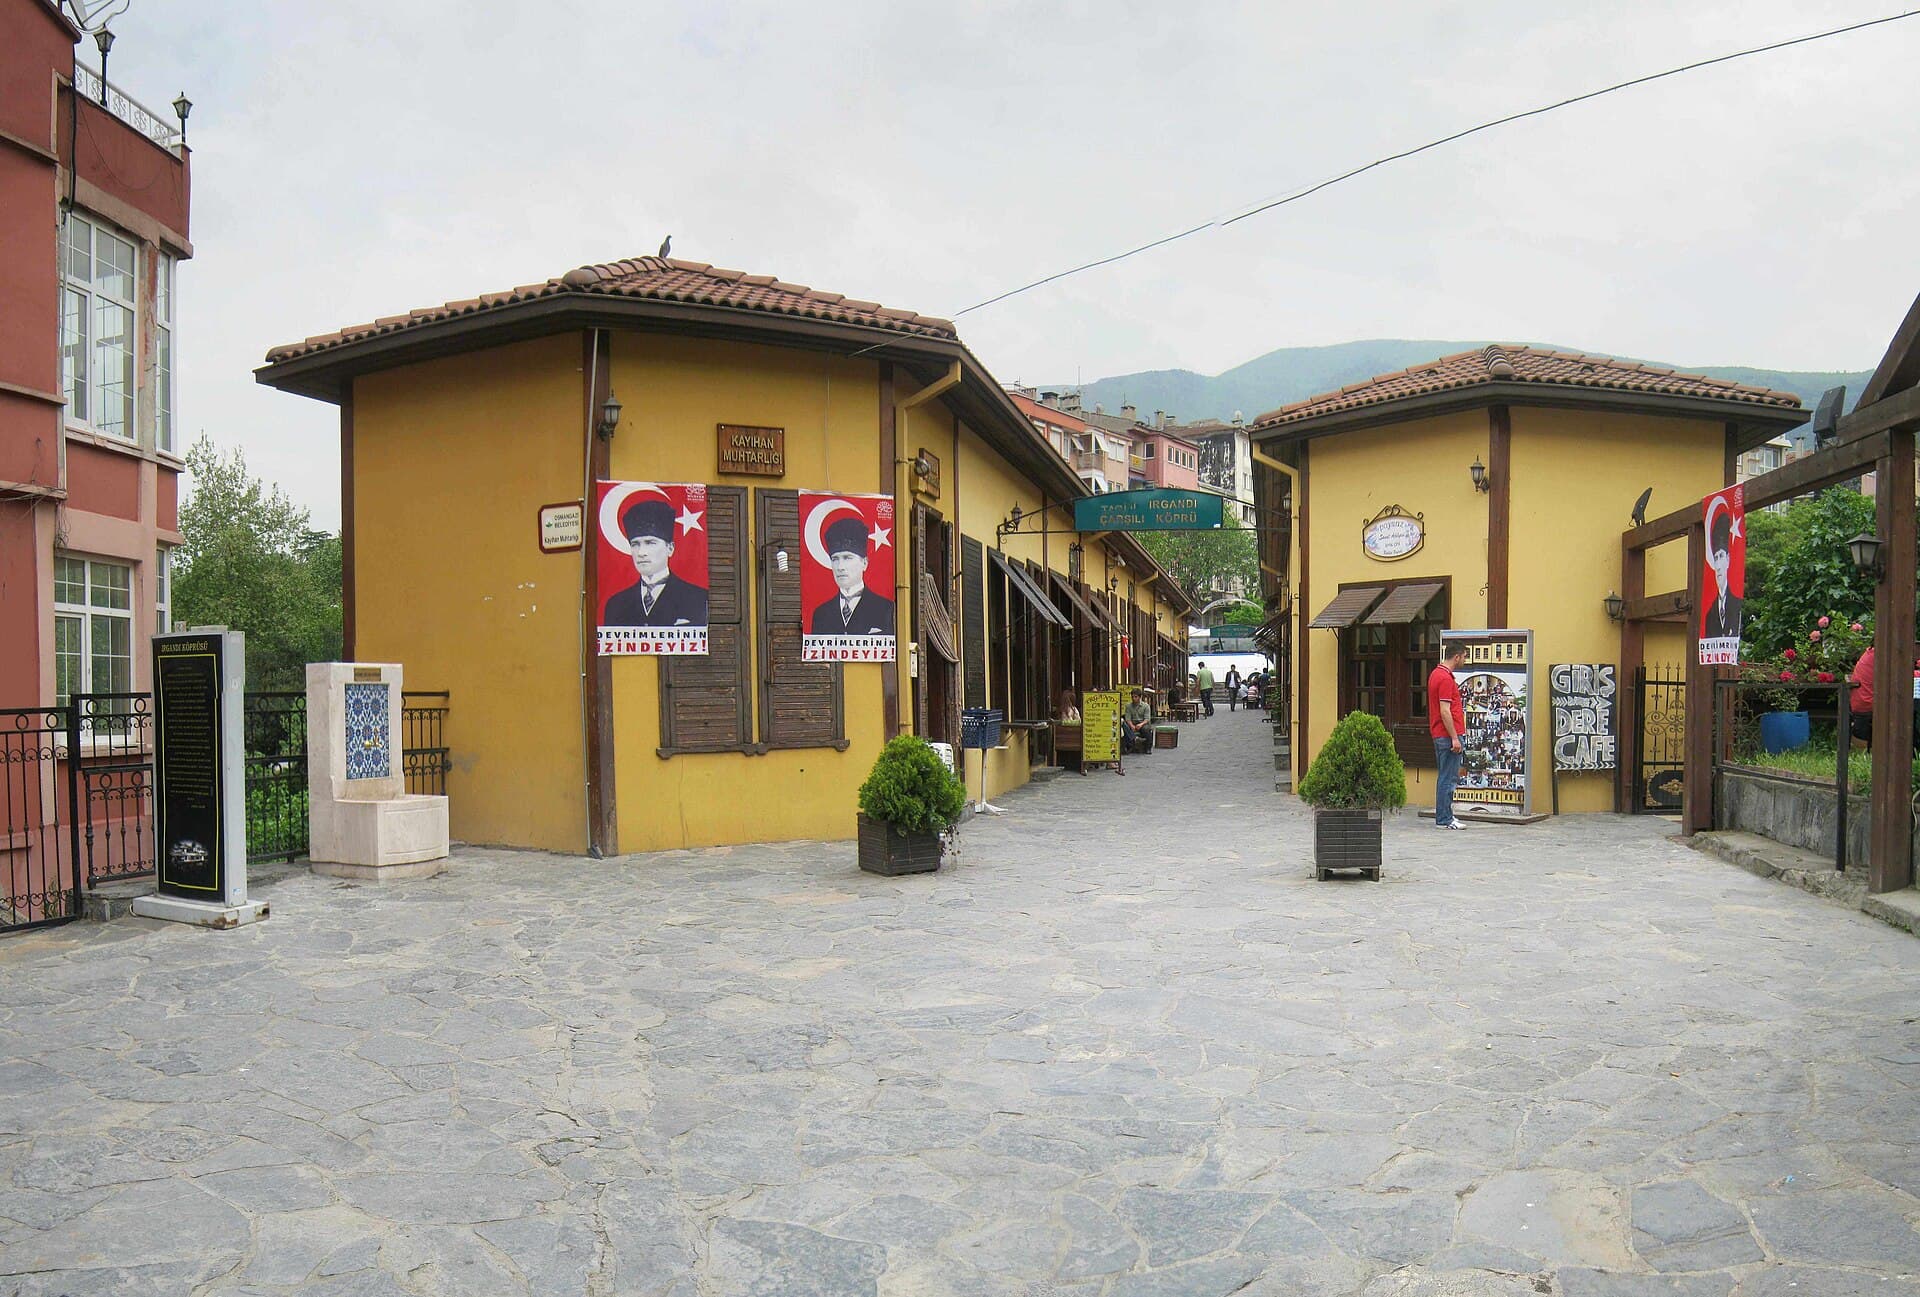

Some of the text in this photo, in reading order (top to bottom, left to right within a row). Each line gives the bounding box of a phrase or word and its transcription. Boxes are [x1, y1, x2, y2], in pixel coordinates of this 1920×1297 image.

[731, 434, 774, 449] KAYIHAN
[723, 449, 782, 465] MUHTARLIĞI
[1149, 499, 1197, 509] IRGANDI
[1156, 512, 1197, 523] KÖPRÜ
[597, 629, 706, 639] DEVRİMLERİNİN
[597, 640, 706, 653] İZİNDEYİZ!
[804, 638, 895, 647] DEVRİMLERİNİN
[803, 647, 895, 660] İZİNDEYİZ!
[1551, 664, 1616, 698] GİRİŞ
[1555, 707, 1610, 737] DERE
[1554, 734, 1616, 765] CAFE
